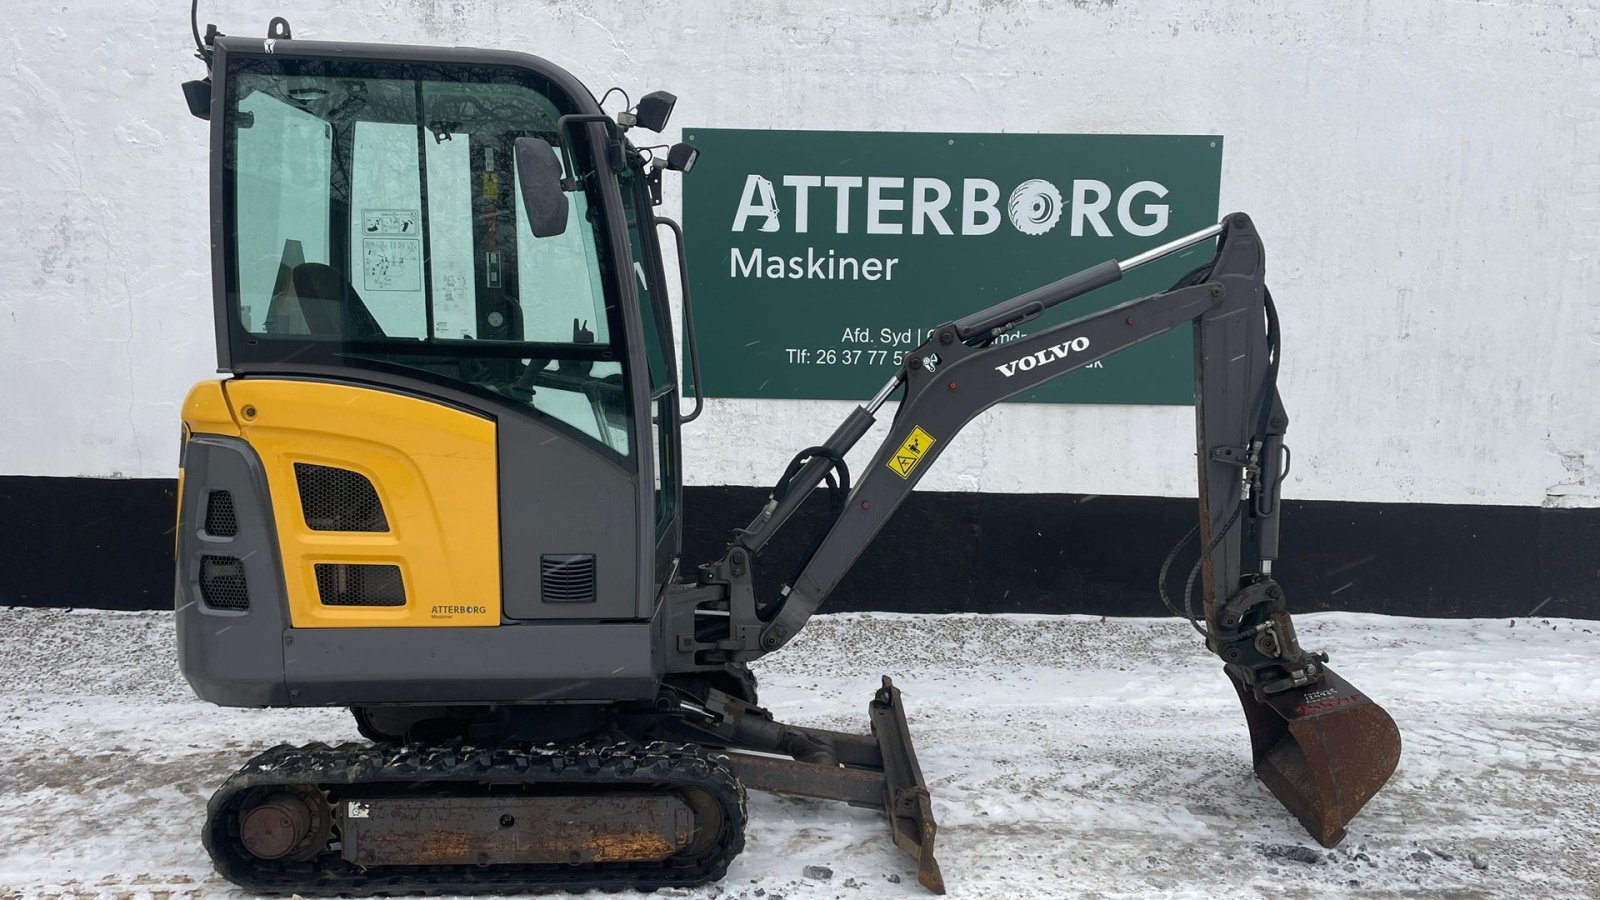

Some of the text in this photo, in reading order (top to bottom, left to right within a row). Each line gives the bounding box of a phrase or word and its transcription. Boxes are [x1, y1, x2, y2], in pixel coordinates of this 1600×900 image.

[731, 174, 1170, 237] ATTERBORG
[731, 247, 898, 282] Maskiner
[841, 327, 875, 343] Afd.
[880, 328, 912, 346] Syd
[785, 349, 811, 365] Tlf:
[816, 350, 837, 365] 26
[841, 351, 863, 366] 37
[868, 351, 888, 367] 77
[995, 336, 1091, 378] VOLVO
[431, 605, 487, 614] ATTERBORG
